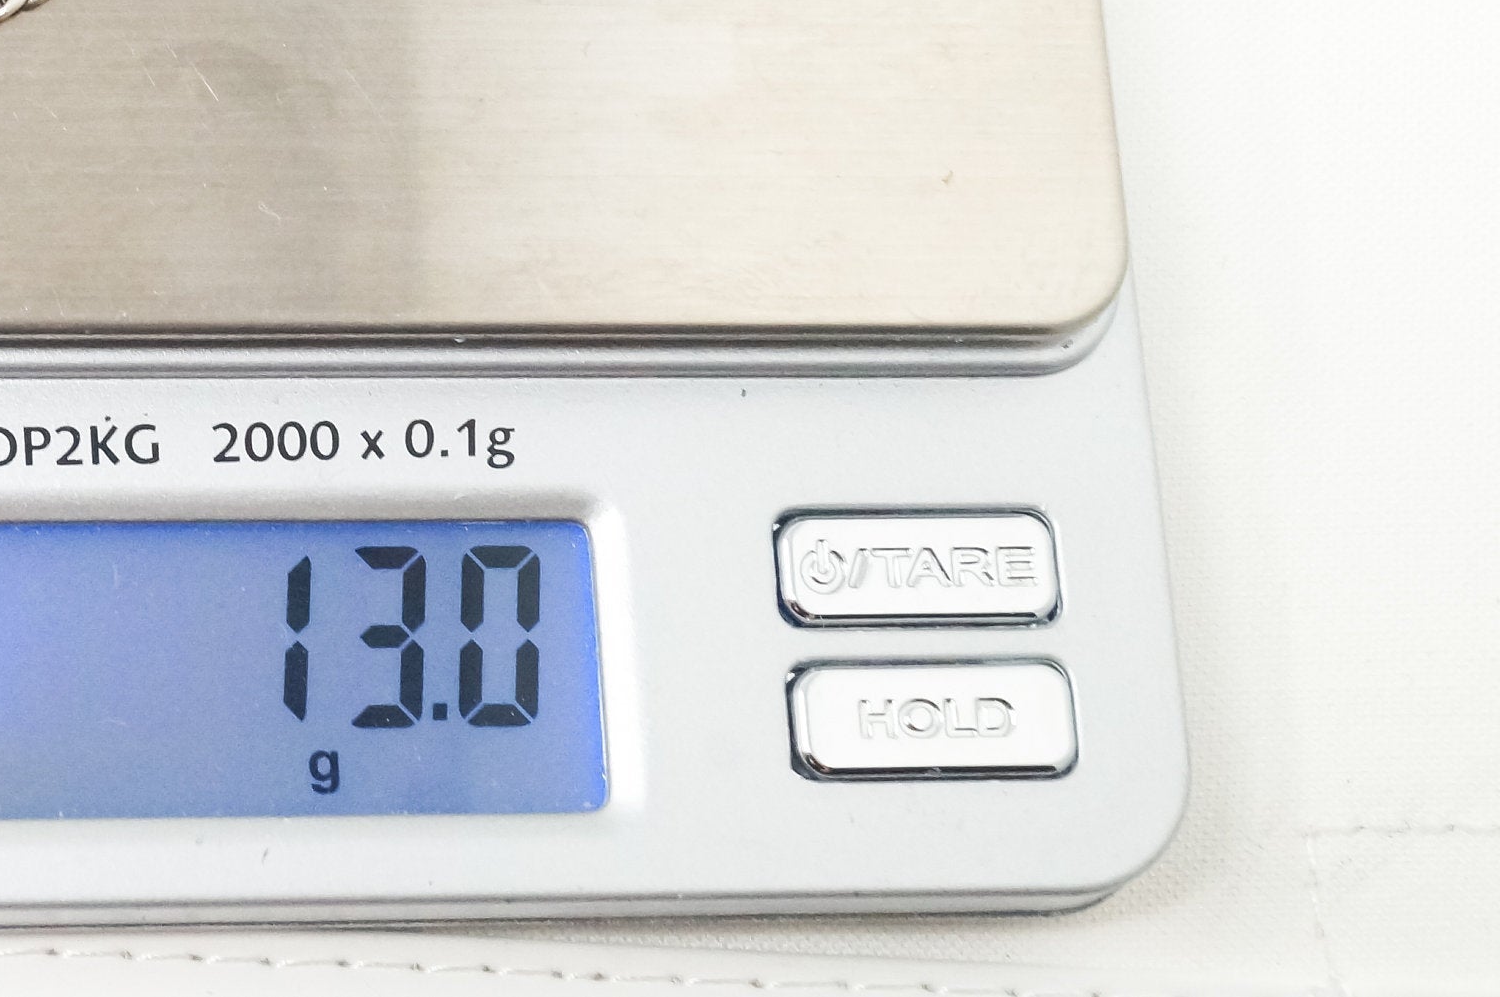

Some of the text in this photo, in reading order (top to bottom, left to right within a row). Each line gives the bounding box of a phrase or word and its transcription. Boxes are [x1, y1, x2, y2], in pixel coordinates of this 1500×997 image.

[211, 420, 341, 464] 2000
[360, 429, 386, 460] x
[404, 418, 517, 470] 0.1g
[283, 545, 540, 728] 13.0
[857, 697, 1018, 740] HOLD
[308, 749, 341, 795] g
